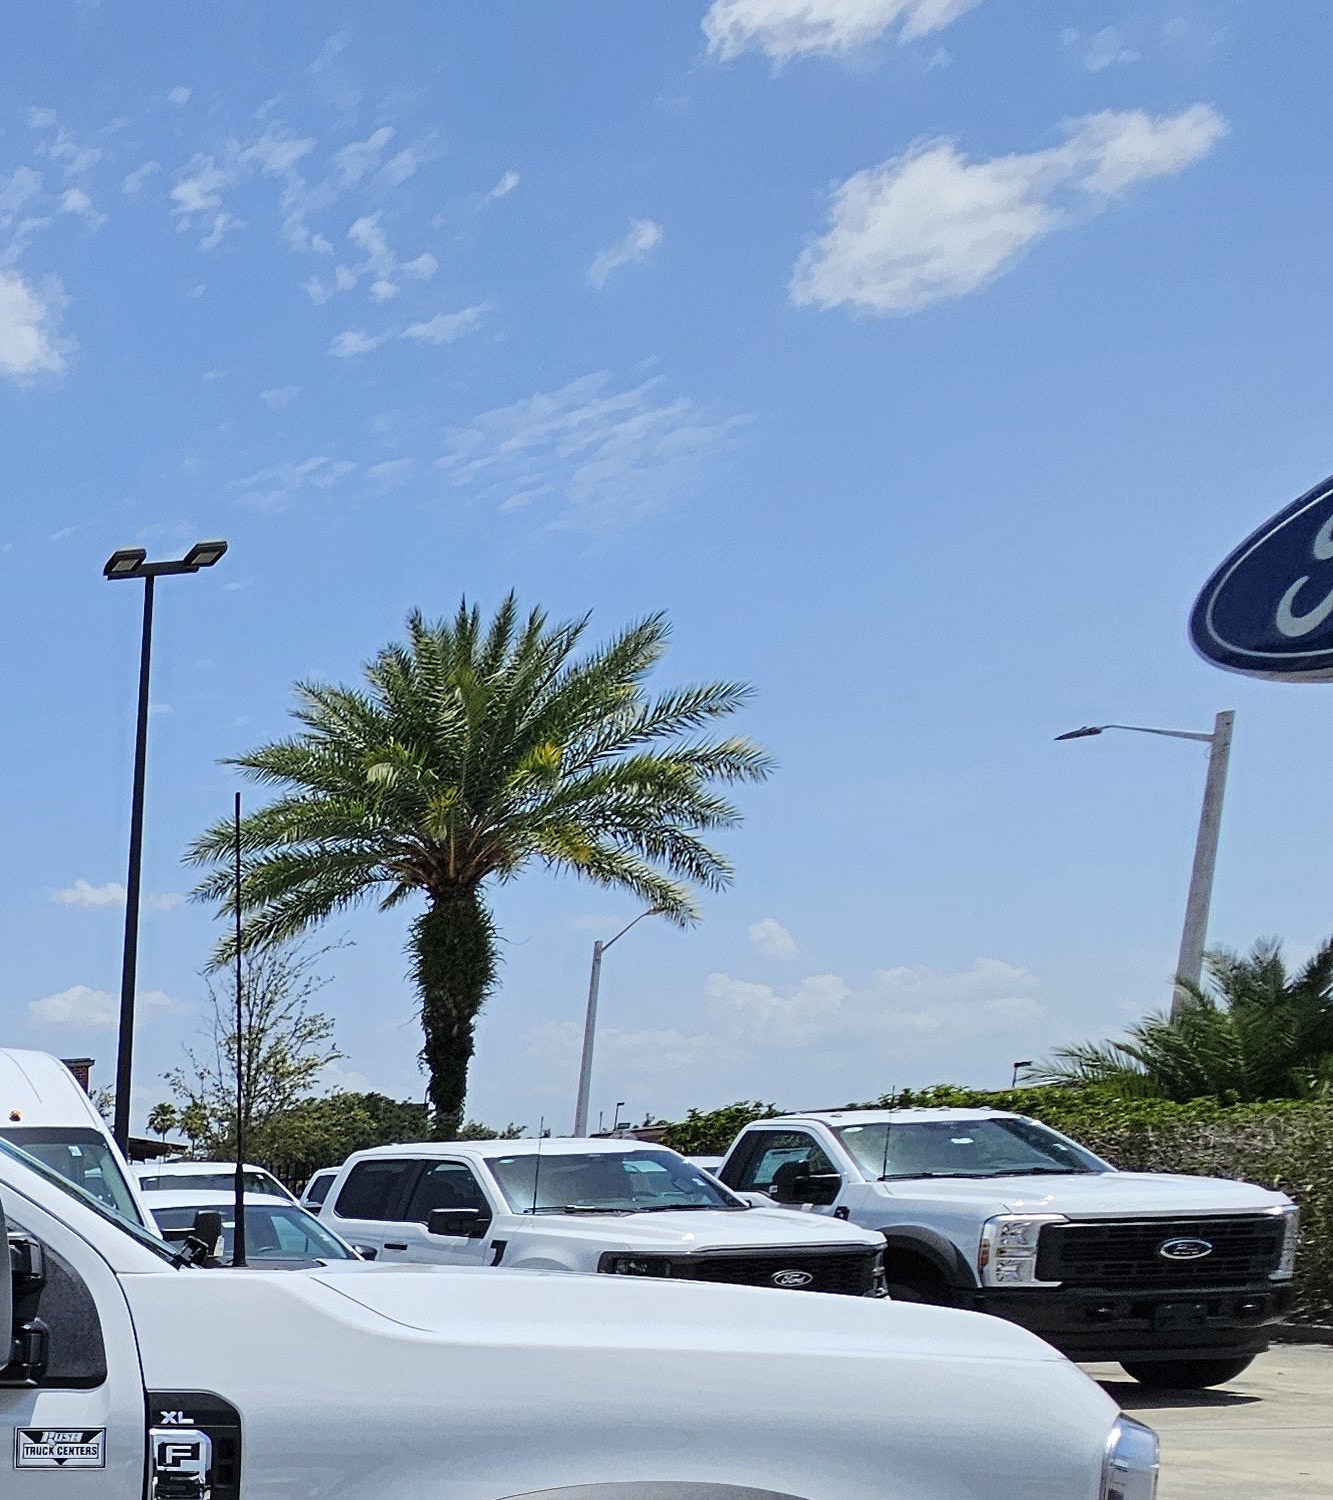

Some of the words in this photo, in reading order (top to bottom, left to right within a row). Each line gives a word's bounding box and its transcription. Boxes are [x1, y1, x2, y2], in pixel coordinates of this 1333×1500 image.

[160, 1411, 195, 1425] XL
[24, 1446, 54, 1456] TRUCK
[56, 1446, 98, 1456] CENTERS
